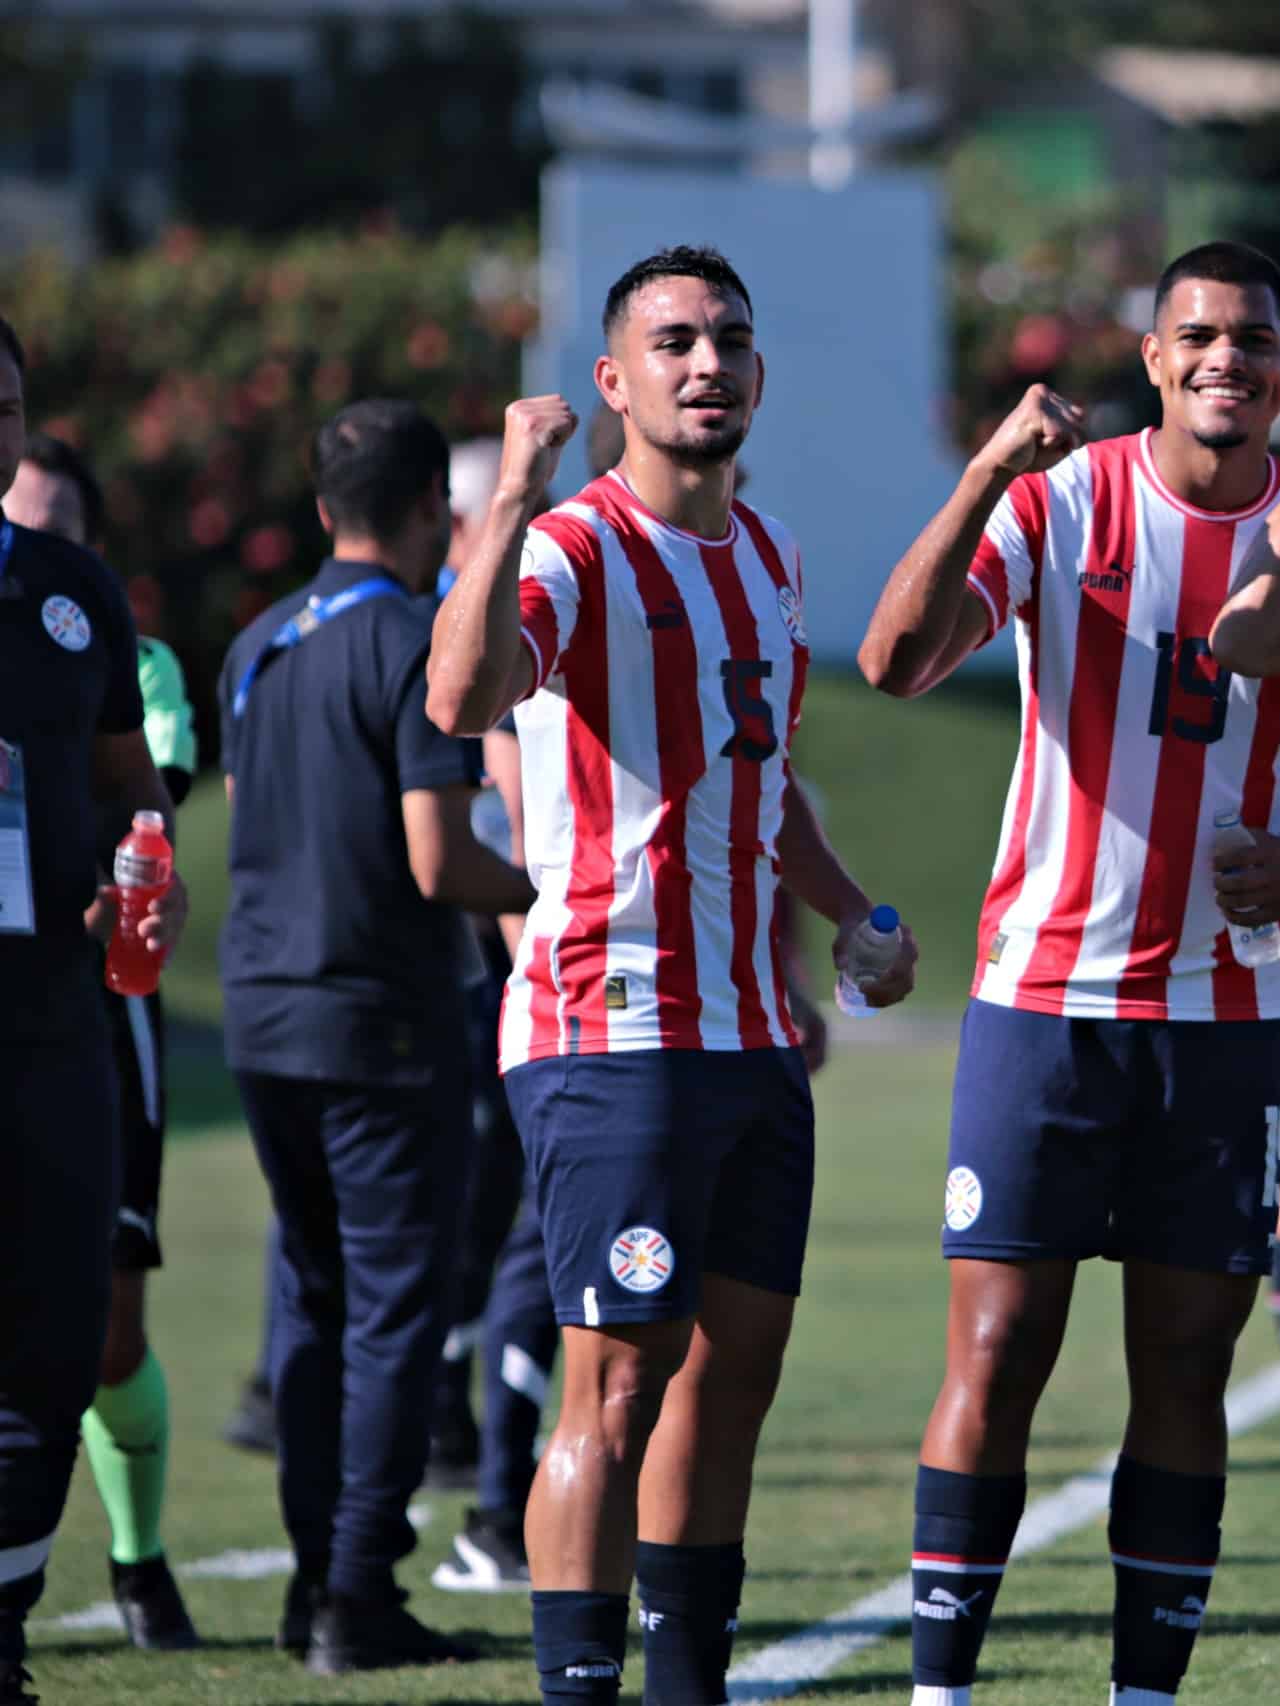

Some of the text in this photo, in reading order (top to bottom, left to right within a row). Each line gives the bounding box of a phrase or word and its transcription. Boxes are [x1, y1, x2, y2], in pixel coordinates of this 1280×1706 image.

[1078, 572, 1124, 593] PUMA
[719, 658, 778, 762] 5
[1147, 631, 1233, 745] 19
[914, 1599, 957, 1620] PUMA
